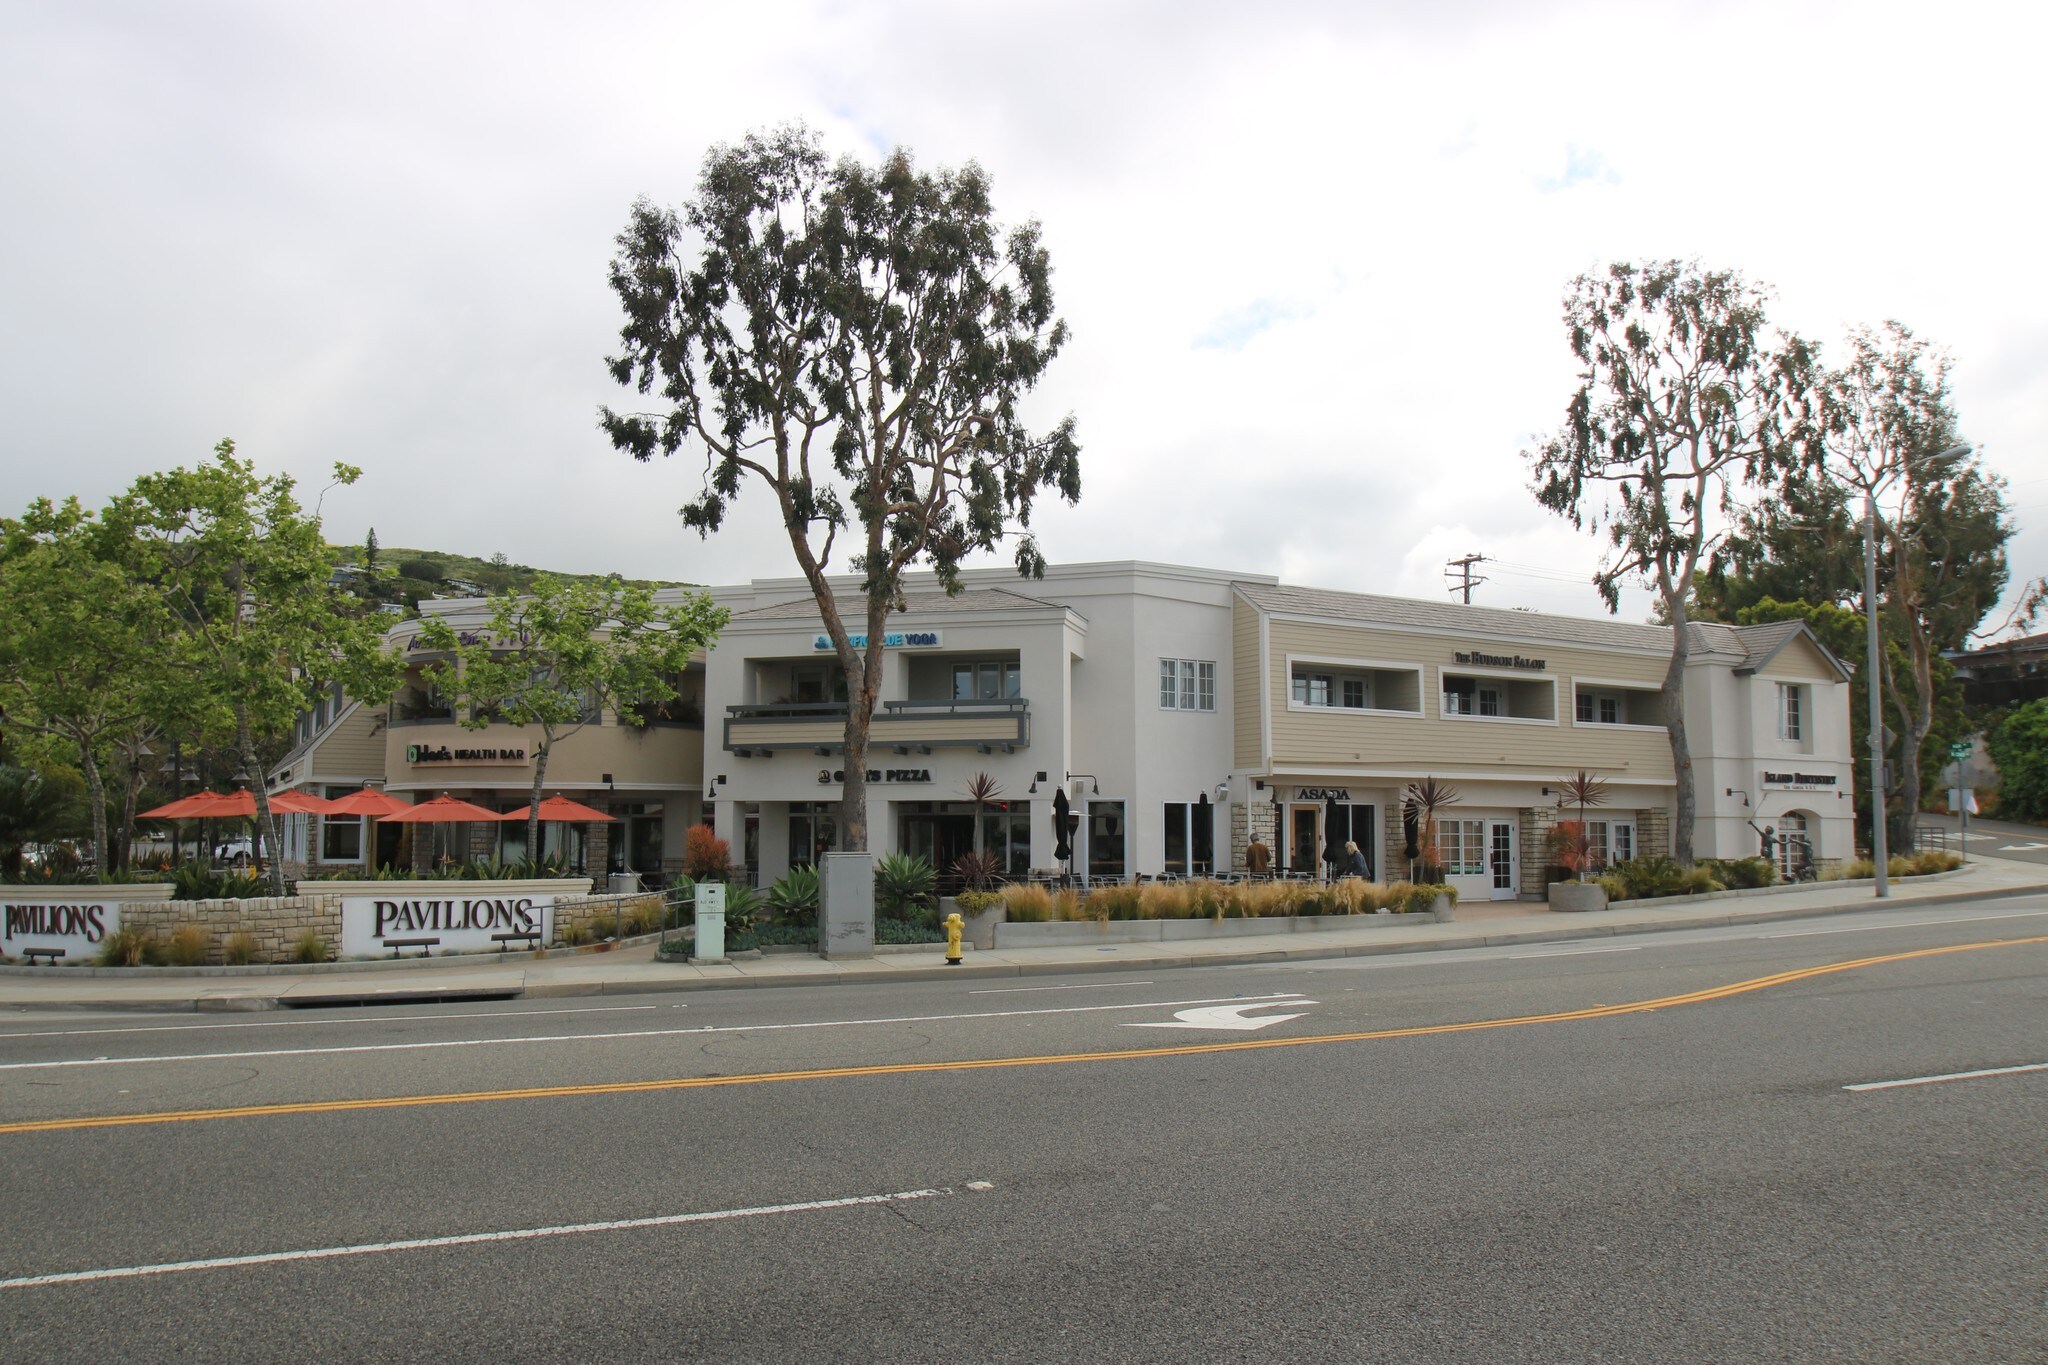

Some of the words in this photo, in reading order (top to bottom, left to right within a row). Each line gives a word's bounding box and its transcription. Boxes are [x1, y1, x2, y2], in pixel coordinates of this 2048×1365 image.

[905, 633, 937, 645] YOGA
[1471, 651, 1512, 666] HUDSON
[1514, 655, 1546, 669] SALON
[455, 749, 497, 759] HEALTH
[500, 749, 525, 759] BAR
[886, 769, 931, 782] PIZZA
[1297, 788, 1351, 800] ASADA
[5, 904, 105, 943] PAVILIONS
[373, 898, 533, 937] PAVILIONS
